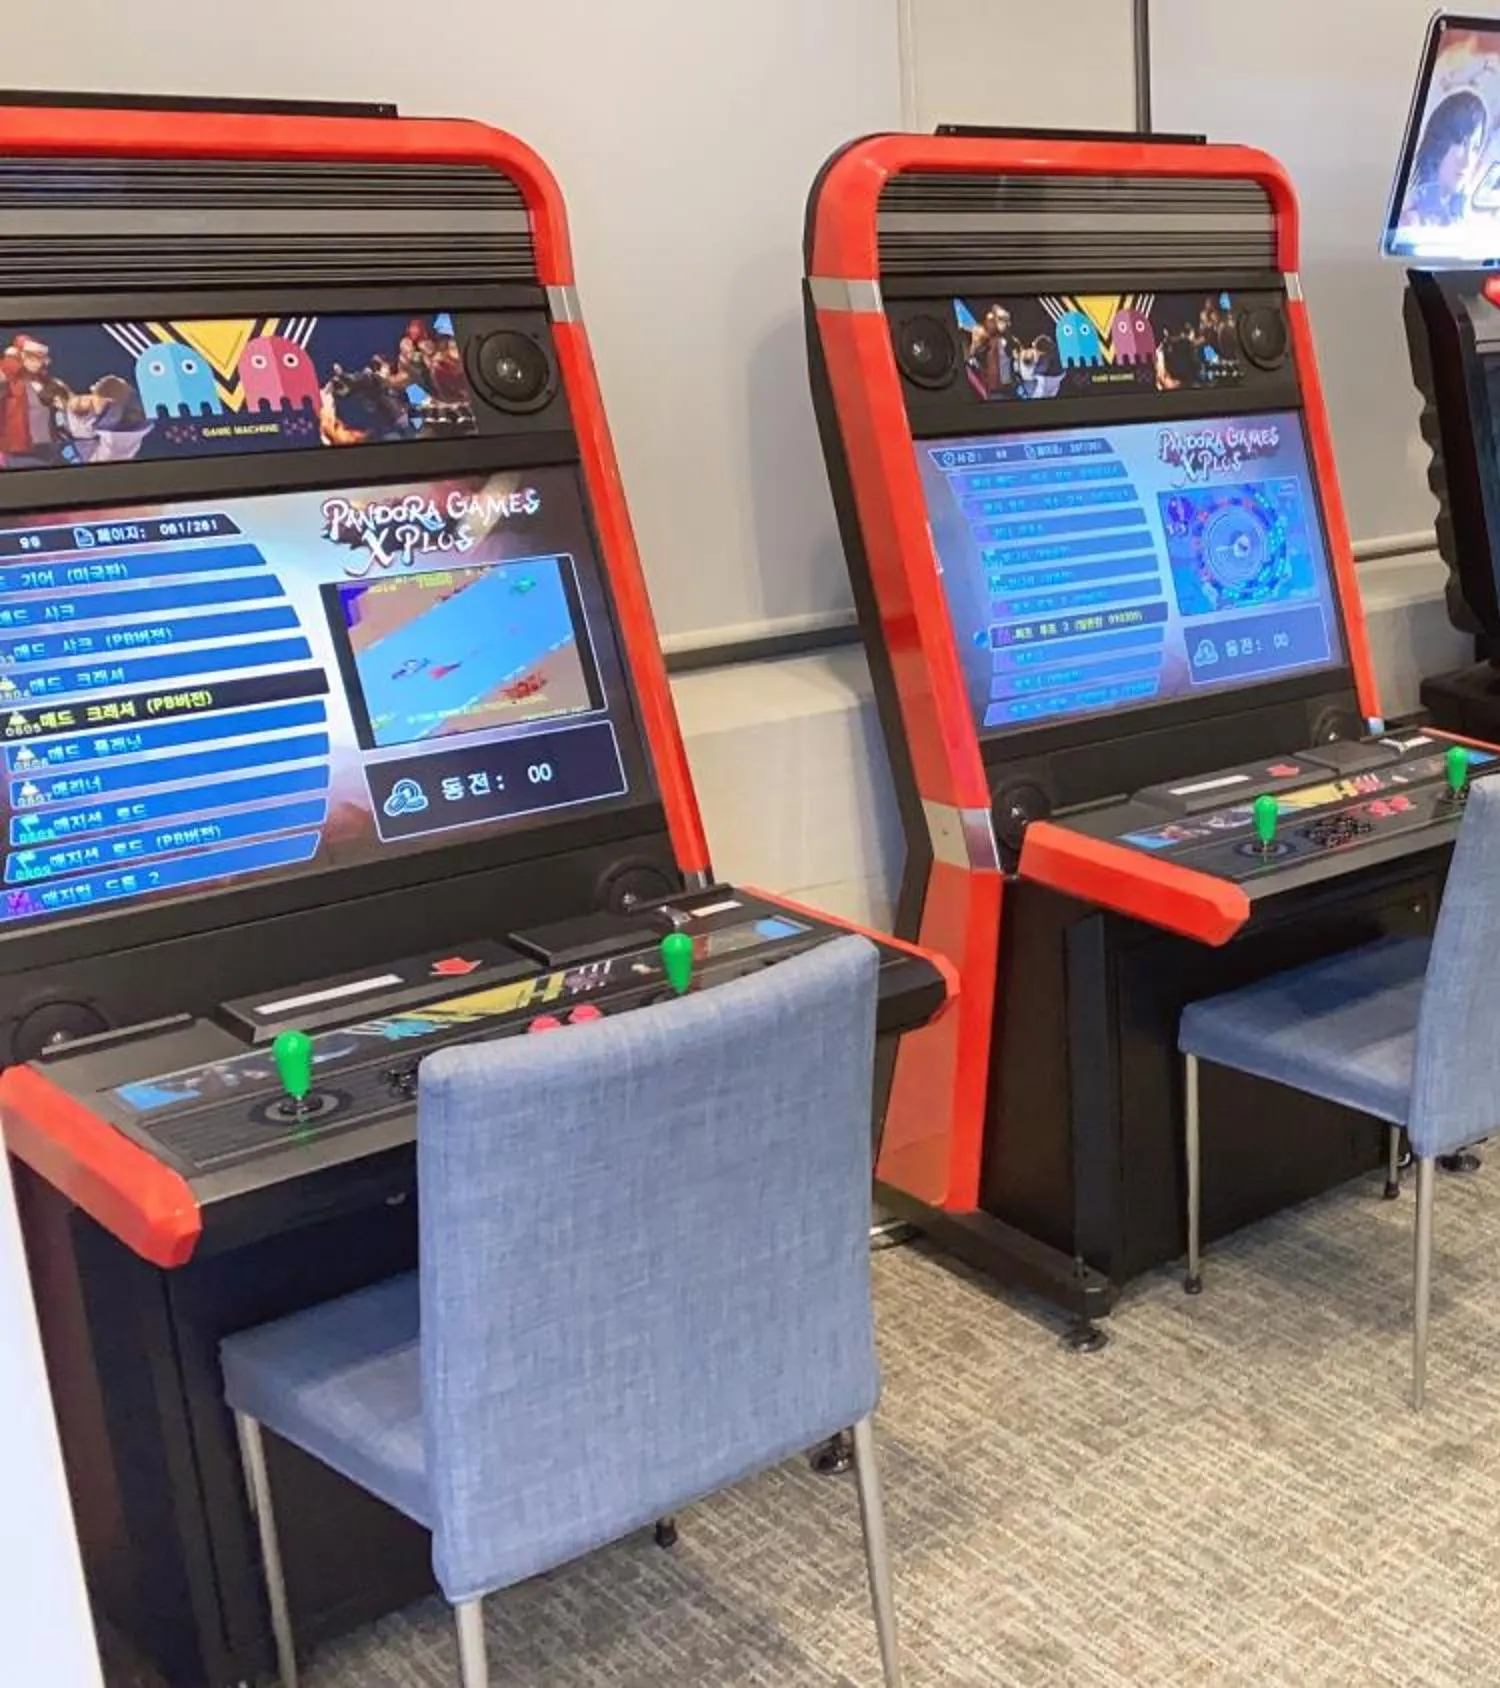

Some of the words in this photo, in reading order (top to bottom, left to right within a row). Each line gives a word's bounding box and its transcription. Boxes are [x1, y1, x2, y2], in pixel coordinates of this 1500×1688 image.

[1159, 428, 1225, 461] PANDORA
[1225, 426, 1280, 452] GAMES
[1198, 450, 1241, 481] PLUS
[323, 495, 444, 541] PANDORA
[446, 487, 541, 525] GAMES
[97, 525, 146, 544] 페이지:
[344, 527, 393, 576] X
[395, 524, 475, 566] PLUS
[20, 569, 55, 589] 기어
[441, 771, 505, 801] 동전:
[527, 762, 553, 785] 00
[147, 871, 160, 886] 2
